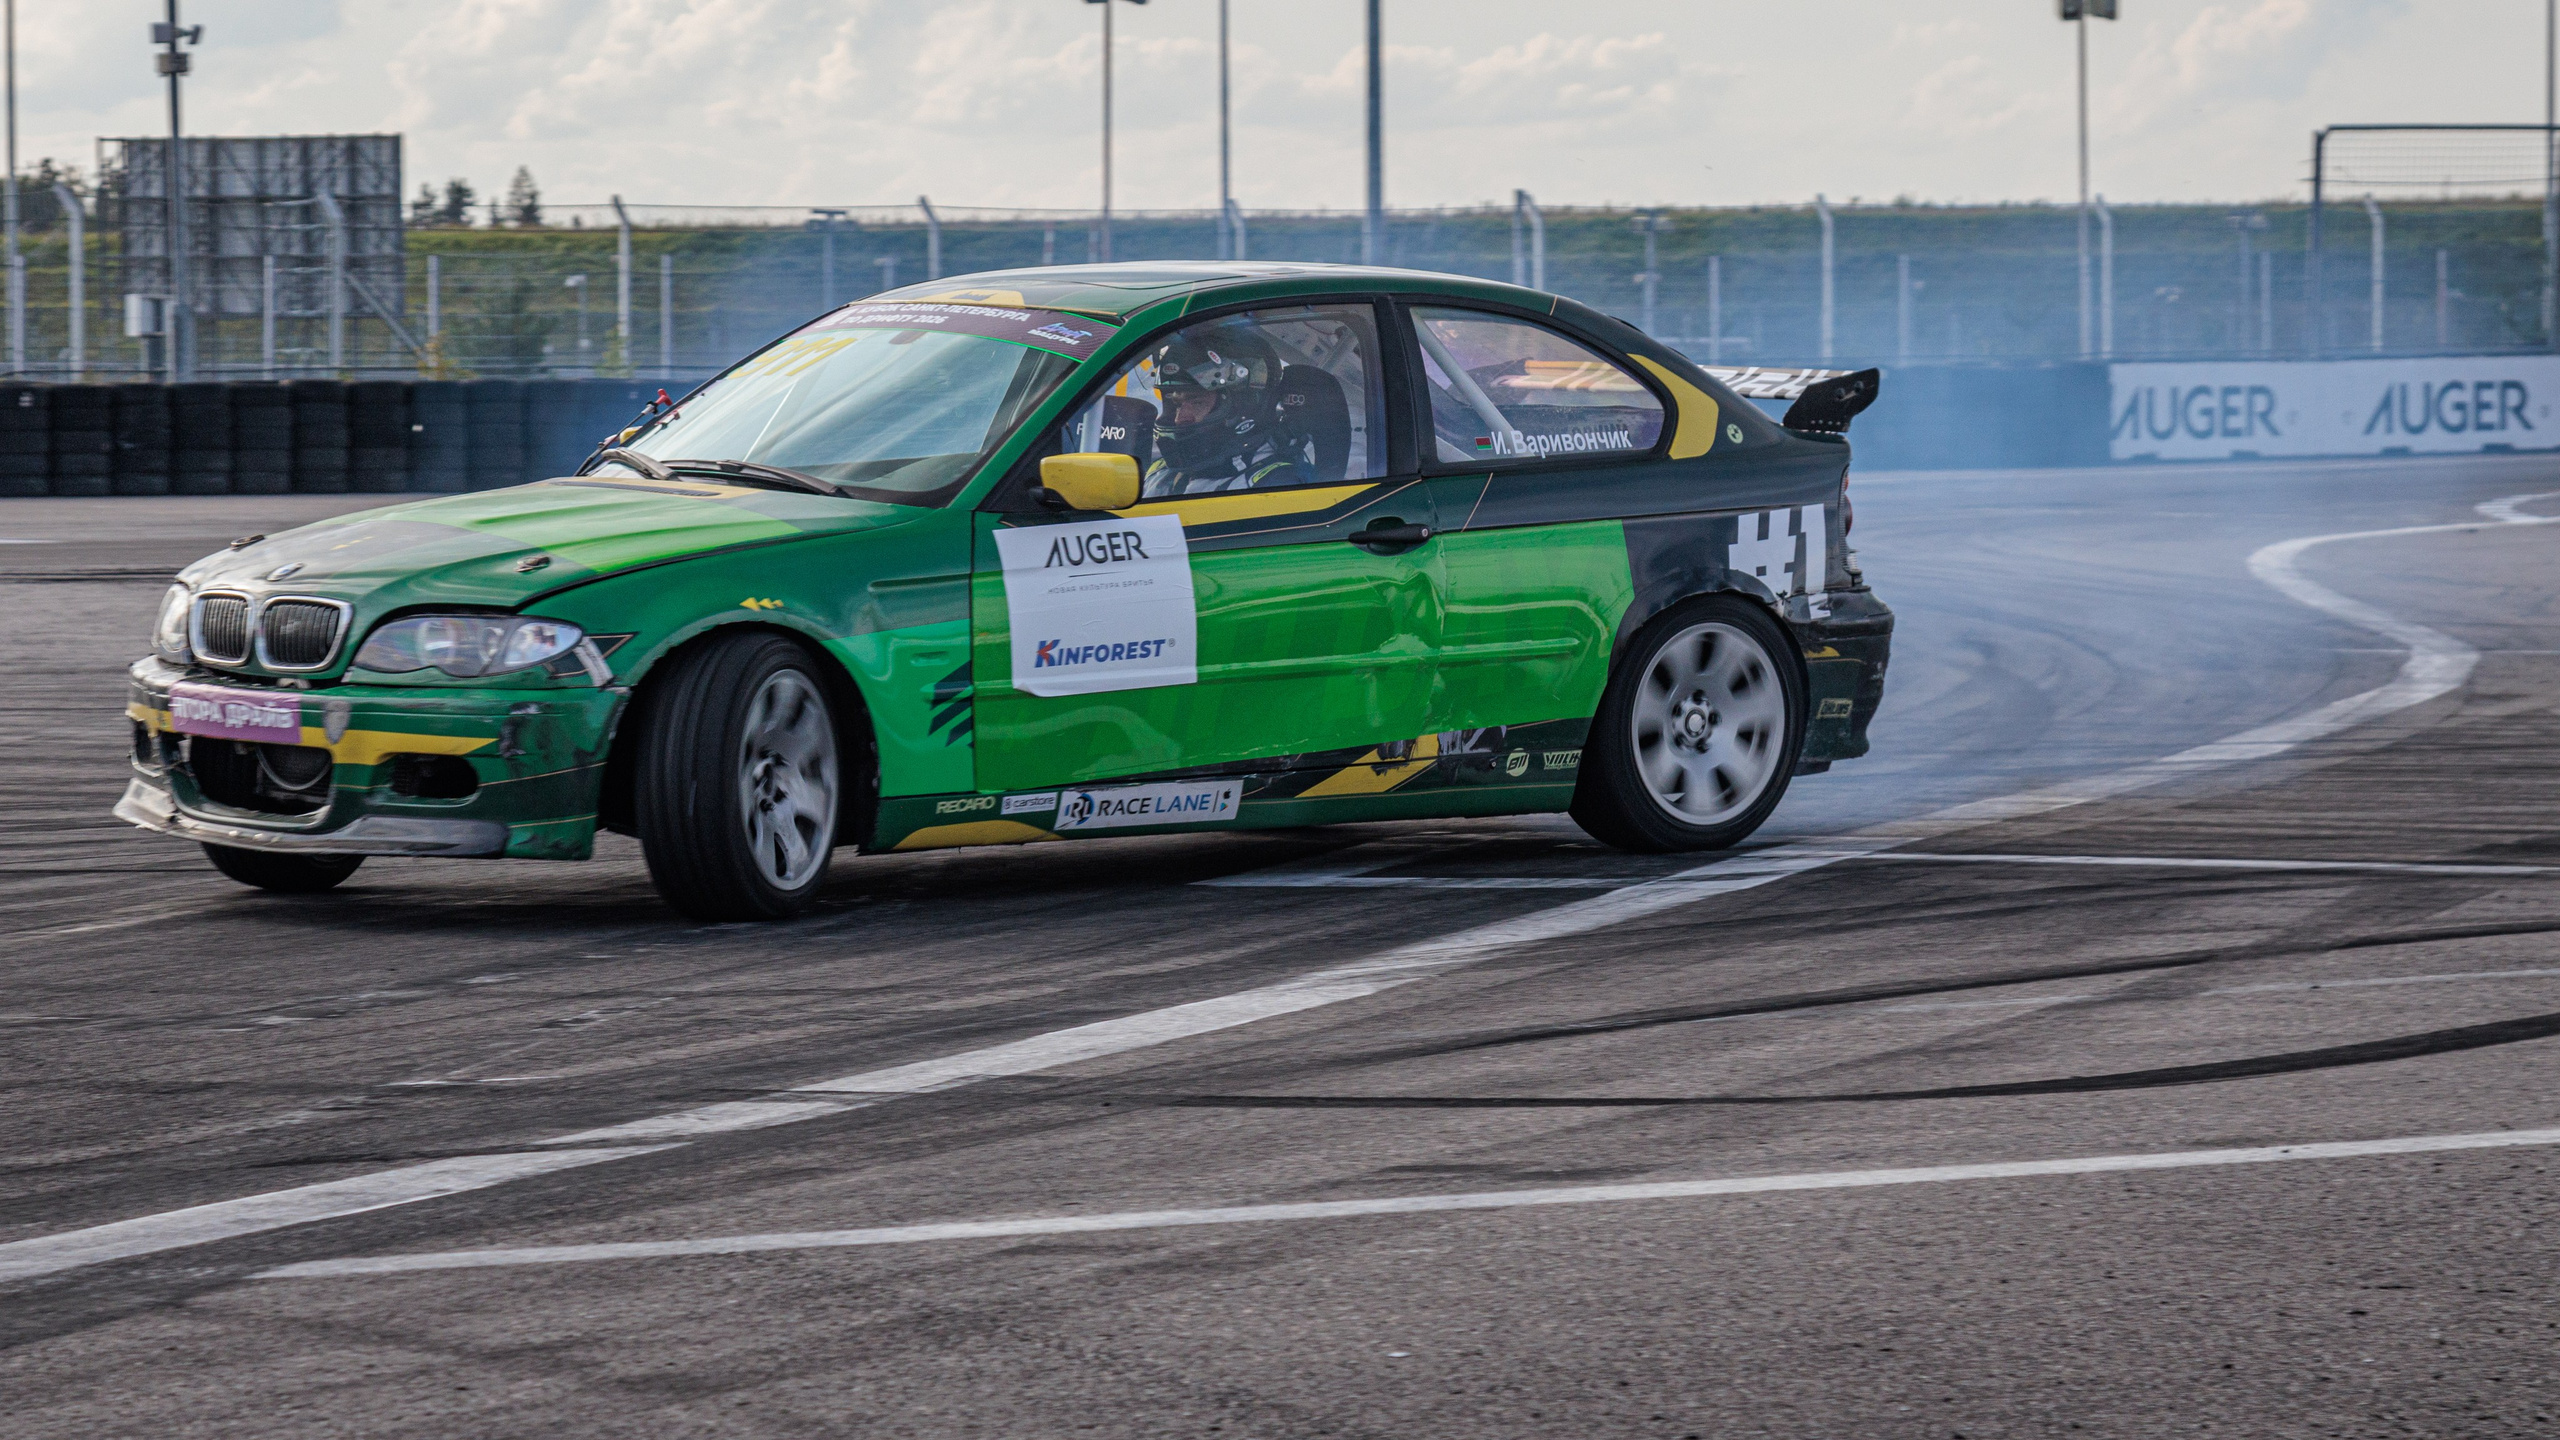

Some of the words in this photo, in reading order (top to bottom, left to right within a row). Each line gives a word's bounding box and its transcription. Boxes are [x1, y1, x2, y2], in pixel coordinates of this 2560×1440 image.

[2110, 385, 2283, 440] AUGER
[2363, 379, 2535, 435] AUGER
[1491, 431, 1512, 455] И.
[1513, 429, 1633, 458] Варивончик
[1044, 531, 1149, 568] AUGER
[1034, 639, 1166, 668] KINFOREST
[935, 796, 996, 814] RECARO
[1097, 797, 1151, 817] RACE
[1155, 793, 1212, 813] LANE
